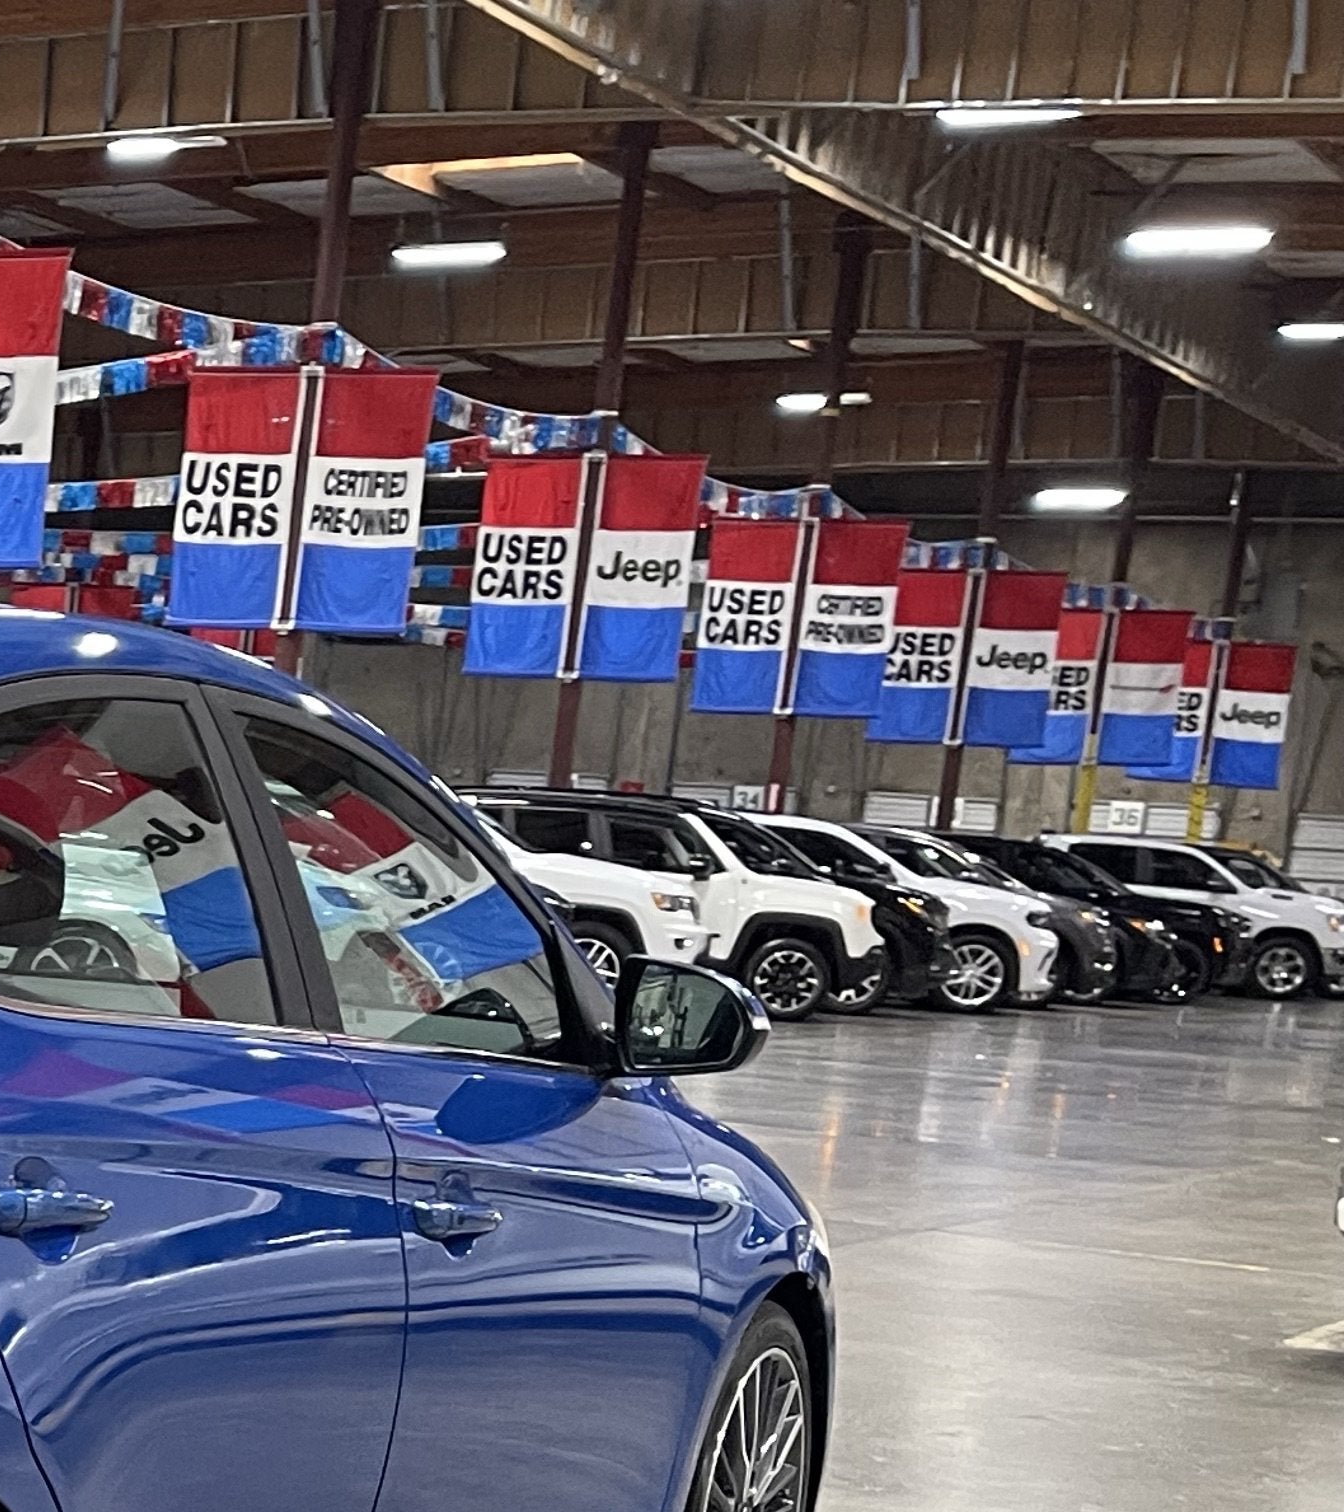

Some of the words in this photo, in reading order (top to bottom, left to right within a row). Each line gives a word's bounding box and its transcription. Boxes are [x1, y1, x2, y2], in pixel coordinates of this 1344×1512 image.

[186, 460, 282, 499] USED
[324, 468, 408, 498] CERTIFIED
[182, 500, 279, 538] CARS
[309, 504, 410, 536] PRE-OWNED
[482, 533, 567, 565] USED
[477, 566, 563, 600] CARS
[597, 551, 681, 588] Jeep
[708, 586, 785, 615] USED
[705, 616, 782, 646] CARS
[976, 644, 1047, 675] Jeep
[1220, 703, 1282, 730] Jeep
[1112, 807, 1140, 827] 36
